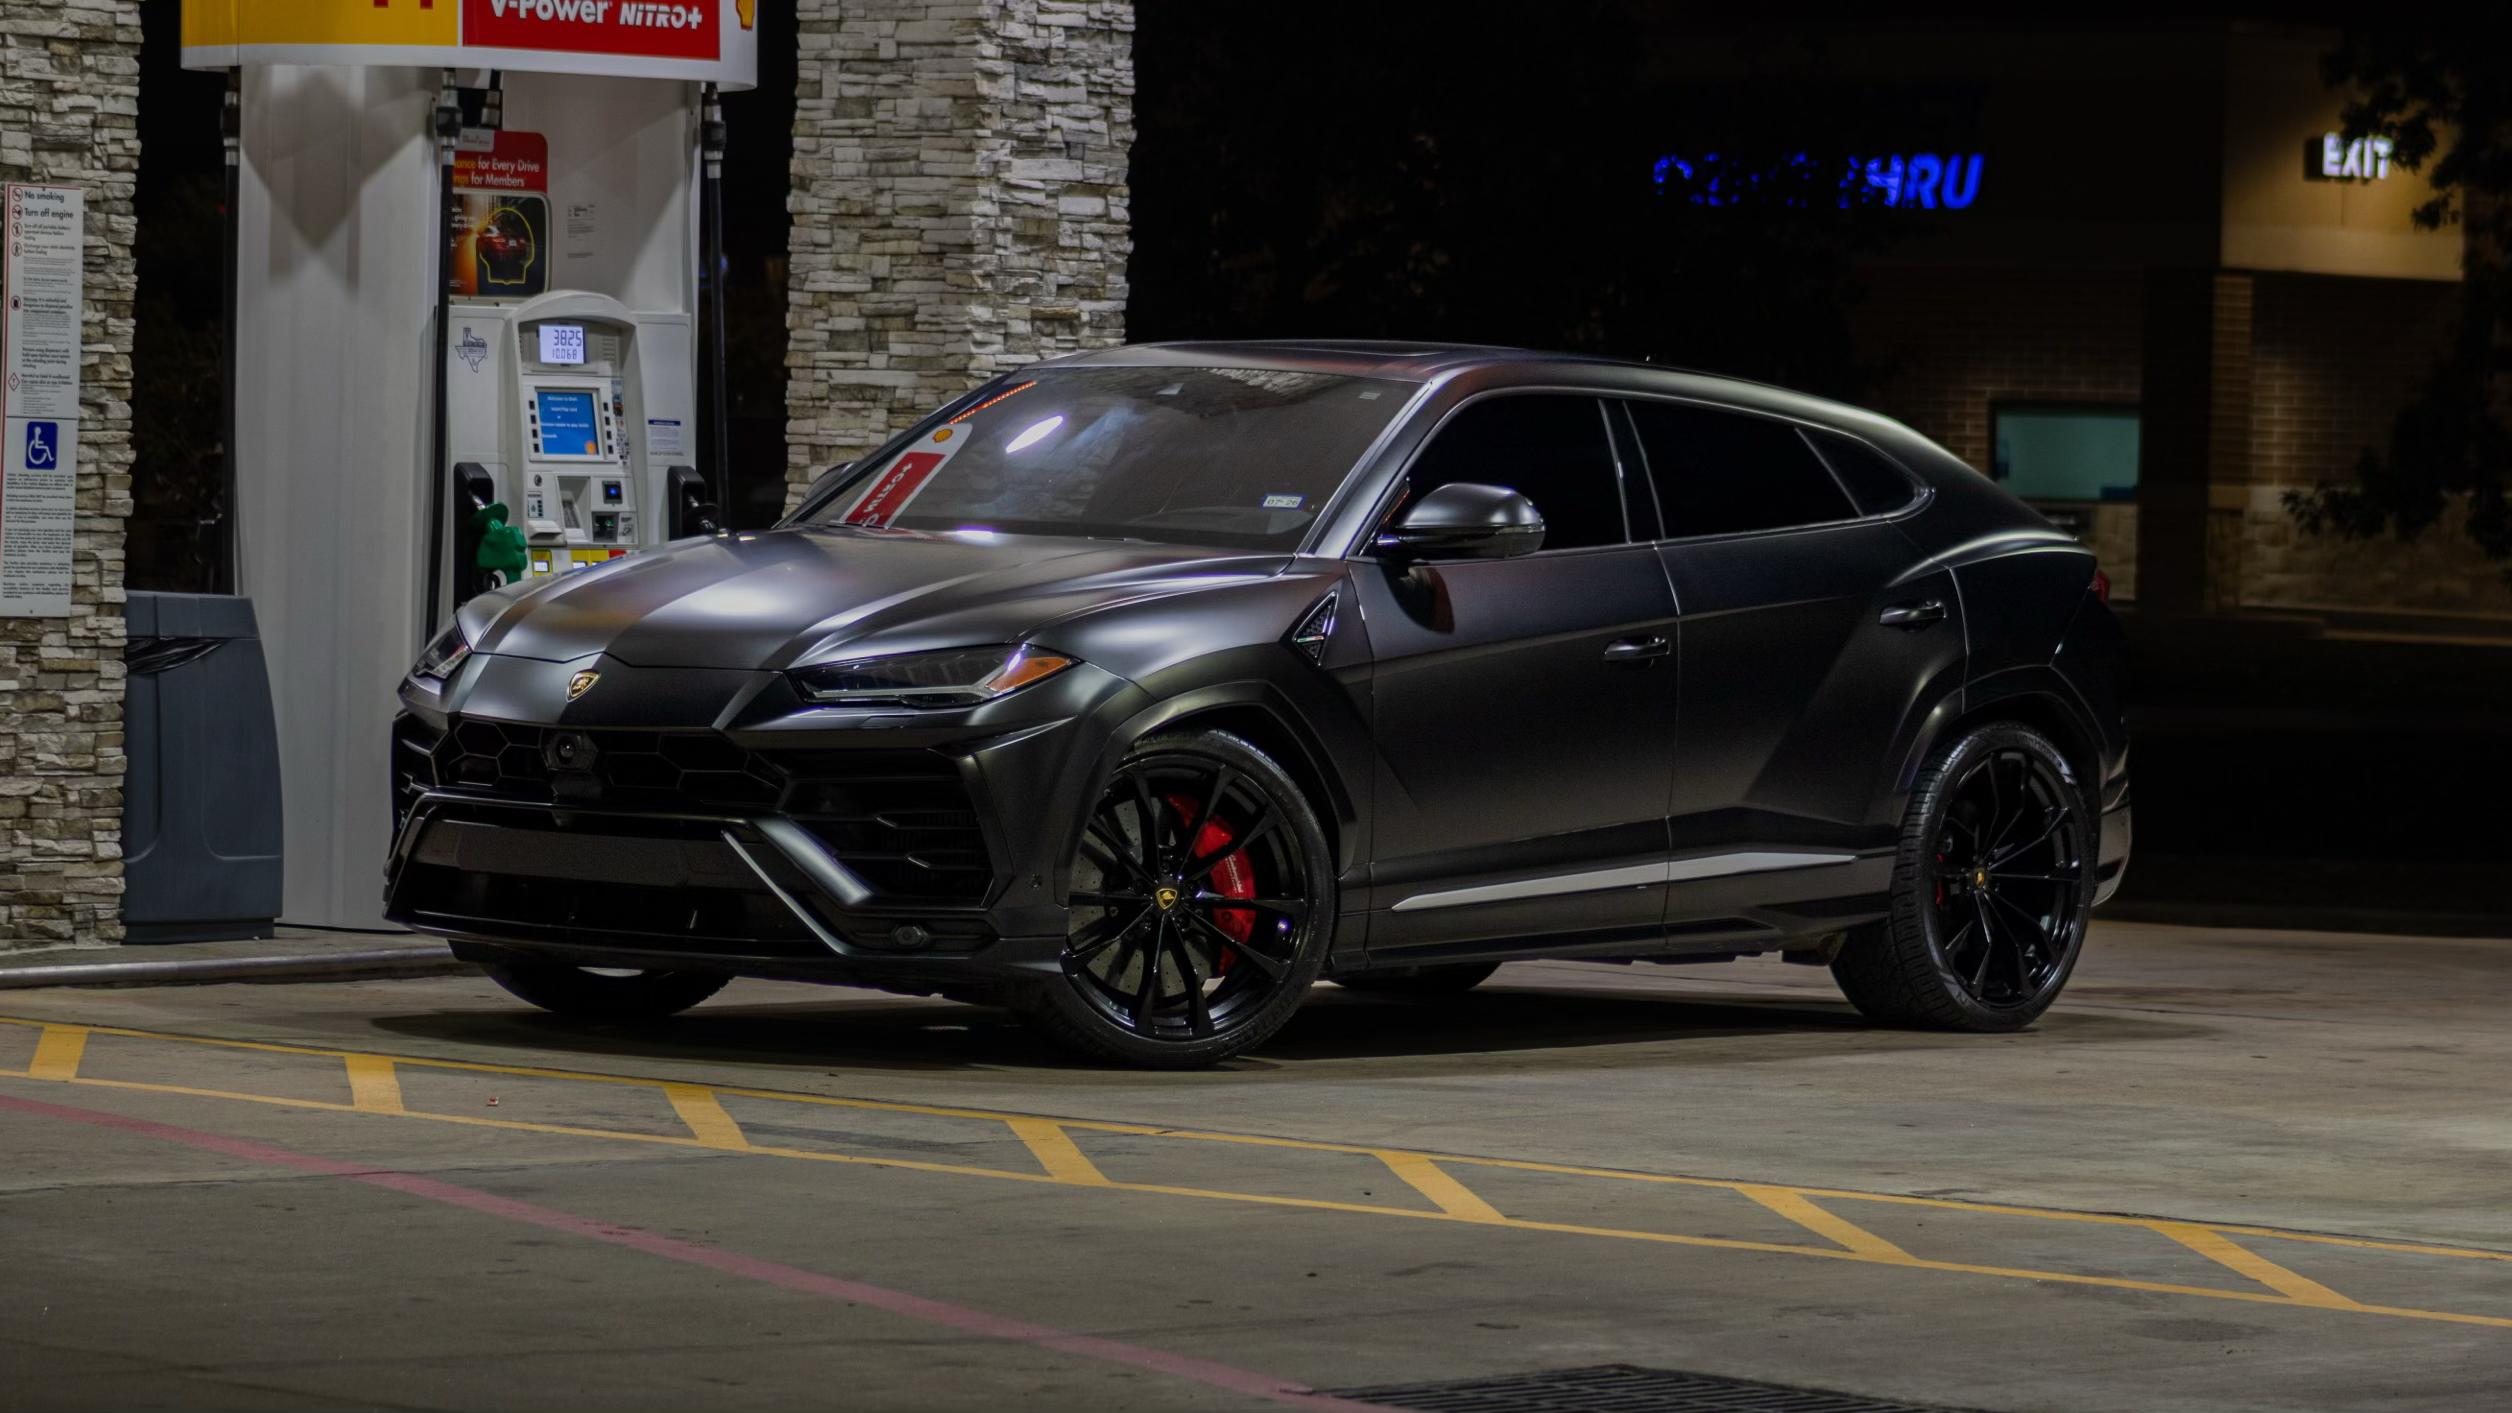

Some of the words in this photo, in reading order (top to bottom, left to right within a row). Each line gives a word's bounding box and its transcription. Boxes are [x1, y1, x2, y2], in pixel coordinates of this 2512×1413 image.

[491, 0, 609, 24] V-Power
[2323, 132, 2394, 179] EXIT
[478, 155, 490, 169] for
[492, 158, 515, 175] Every
[517, 159, 540, 173] Drive
[471, 172, 484, 185] for
[485, 174, 525, 187] Members
[25, 191, 35, 200] No
[37, 192, 65, 204] smoking
[25, 208, 39, 217] Turn
[41, 208, 50, 217] off
[51, 210, 74, 220] engine
